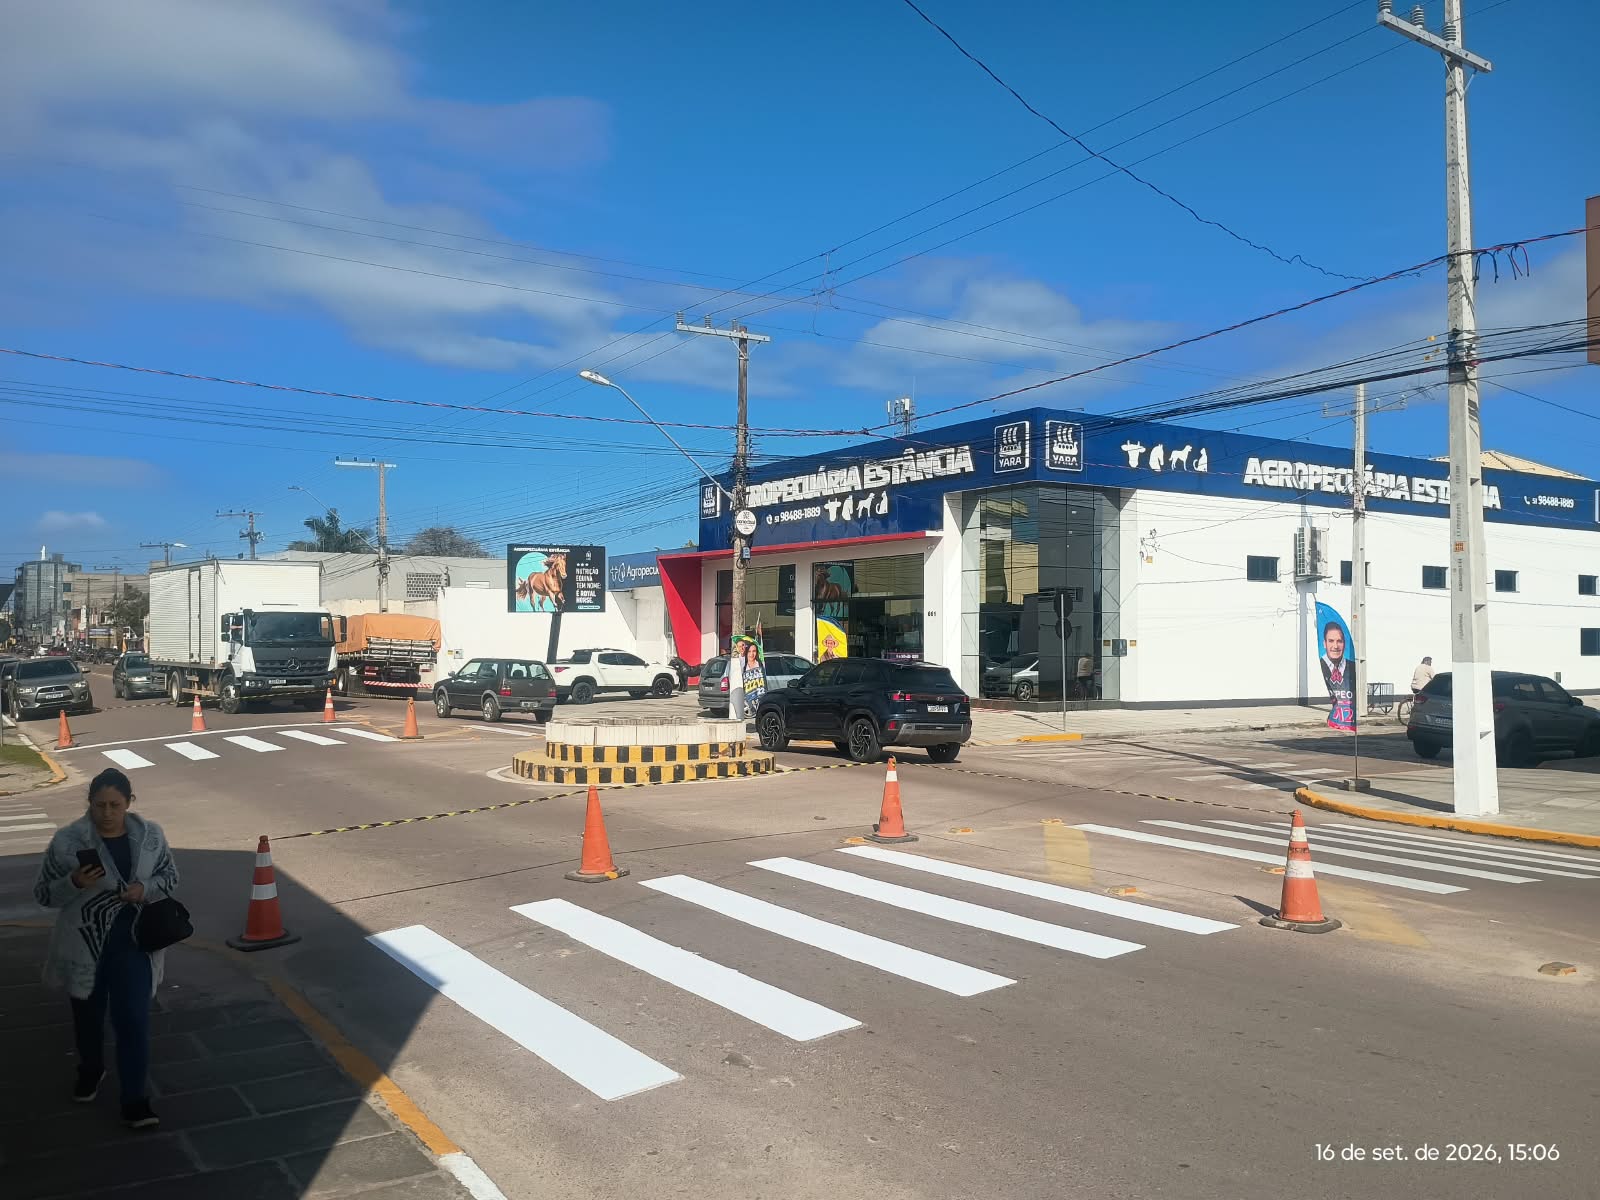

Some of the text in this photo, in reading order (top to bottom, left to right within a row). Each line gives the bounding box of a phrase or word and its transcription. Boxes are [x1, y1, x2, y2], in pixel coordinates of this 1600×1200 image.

[998, 457, 1022, 468] YARA
[1052, 454, 1078, 465] YARA
[729, 445, 975, 510] ROPECUÁRIA ESTÂNCIA
[1411, 477, 1502, 510] ESTIA
[1537, 494, 1575, 508] 98488-1889
[779, 506, 821, 522] 98488-1889
[626, 565, 660, 580] Agropecu
